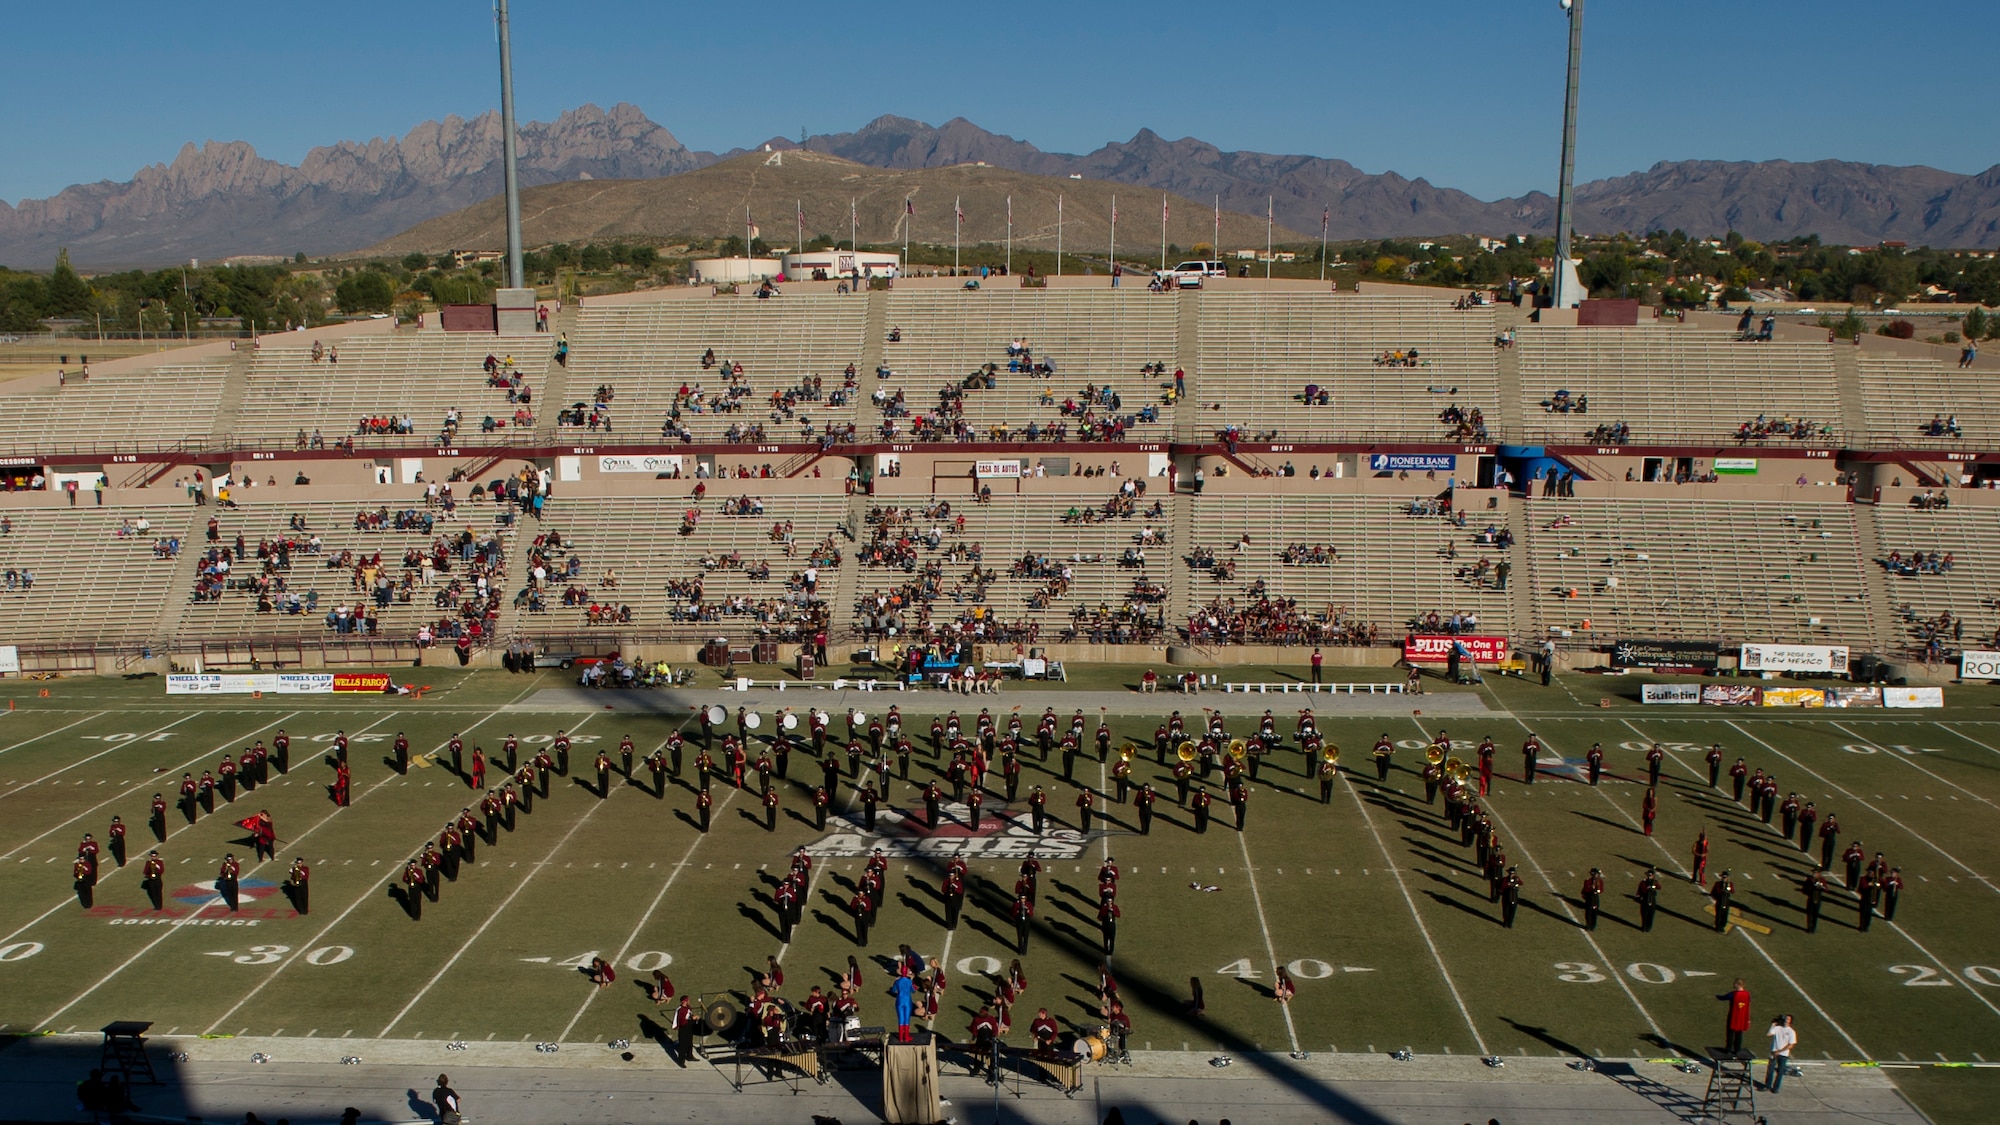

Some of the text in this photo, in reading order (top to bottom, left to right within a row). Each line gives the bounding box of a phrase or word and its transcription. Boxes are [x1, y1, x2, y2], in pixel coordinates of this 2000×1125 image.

[762, 151, 782, 166] A
[1390, 456, 1450, 465] PIONEER BANK
[979, 464, 992, 473] CASA
[1002, 464, 1018, 473] AUTOS
[1414, 638, 1453, 653] PLUS
[1473, 640, 1491, 649] One
[1788, 658, 1823, 666] MEXICO
[334, 678, 361, 687] WELLS
[362, 678, 388, 688] FARGO
[1646, 690, 1698, 701] Bulletin
[803, 833, 1083, 853] AGGIES
[82, 905, 312, 920] SUN BELT
[108, 918, 261, 927] CONFERENCE
[233, 944, 355, 967] 30
[556, 950, 673, 972] 40
[1217, 957, 1334, 980] 40
[1553, 961, 1676, 985] 30
[1887, 964, 2000, 988] 20
